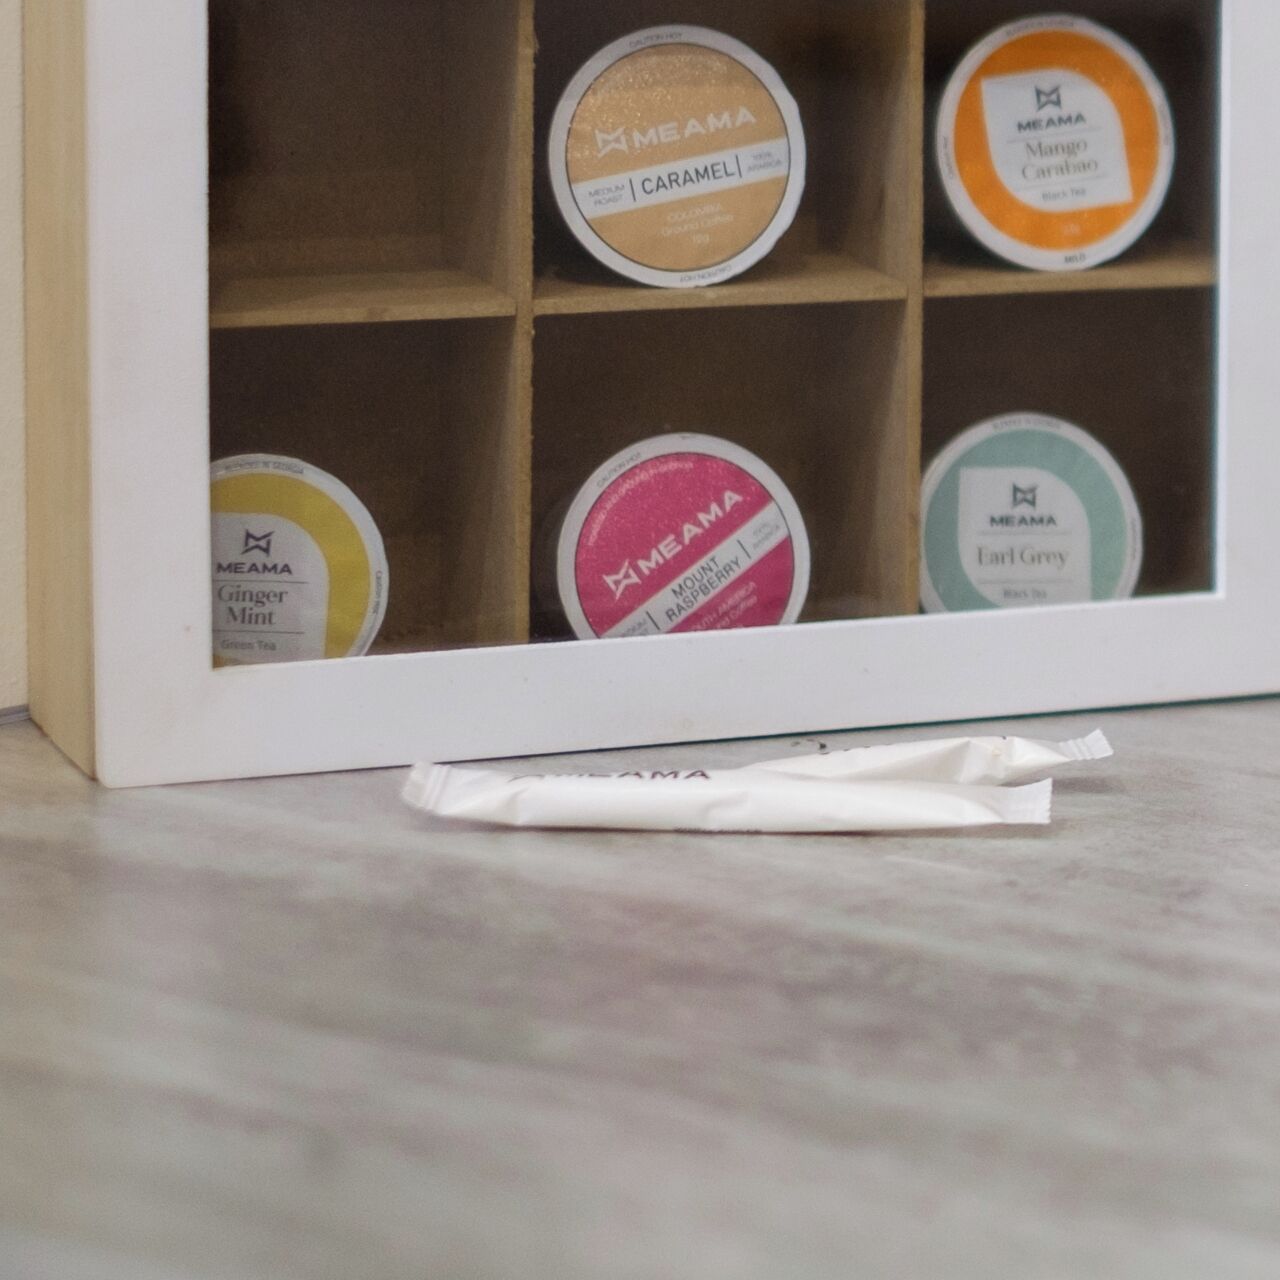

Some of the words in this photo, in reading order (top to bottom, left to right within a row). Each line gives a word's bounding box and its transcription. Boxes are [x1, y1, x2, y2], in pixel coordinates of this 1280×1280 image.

[631, 106, 757, 150] MEAMA
[1017, 113, 1086, 133] MEAMA
[1025, 137, 1088, 160] Mango
[641, 161, 736, 196] CARAMEL
[588, 184, 625, 198] MEDIUM
[990, 516, 1057, 527] MEAMA
[637, 490, 743, 576] MEAMA
[977, 547, 1014, 565] Earl
[1021, 548, 1070, 568] Grey
[216, 563, 292, 575] MEAMA
[671, 555, 719, 598] MOUNT
[217, 585, 288, 607] Ginger
[665, 556, 742, 622] RASPBERRY
[227, 606, 275, 626] Mint
[220, 640, 255, 651] Green
[257, 640, 277, 651] Tea
